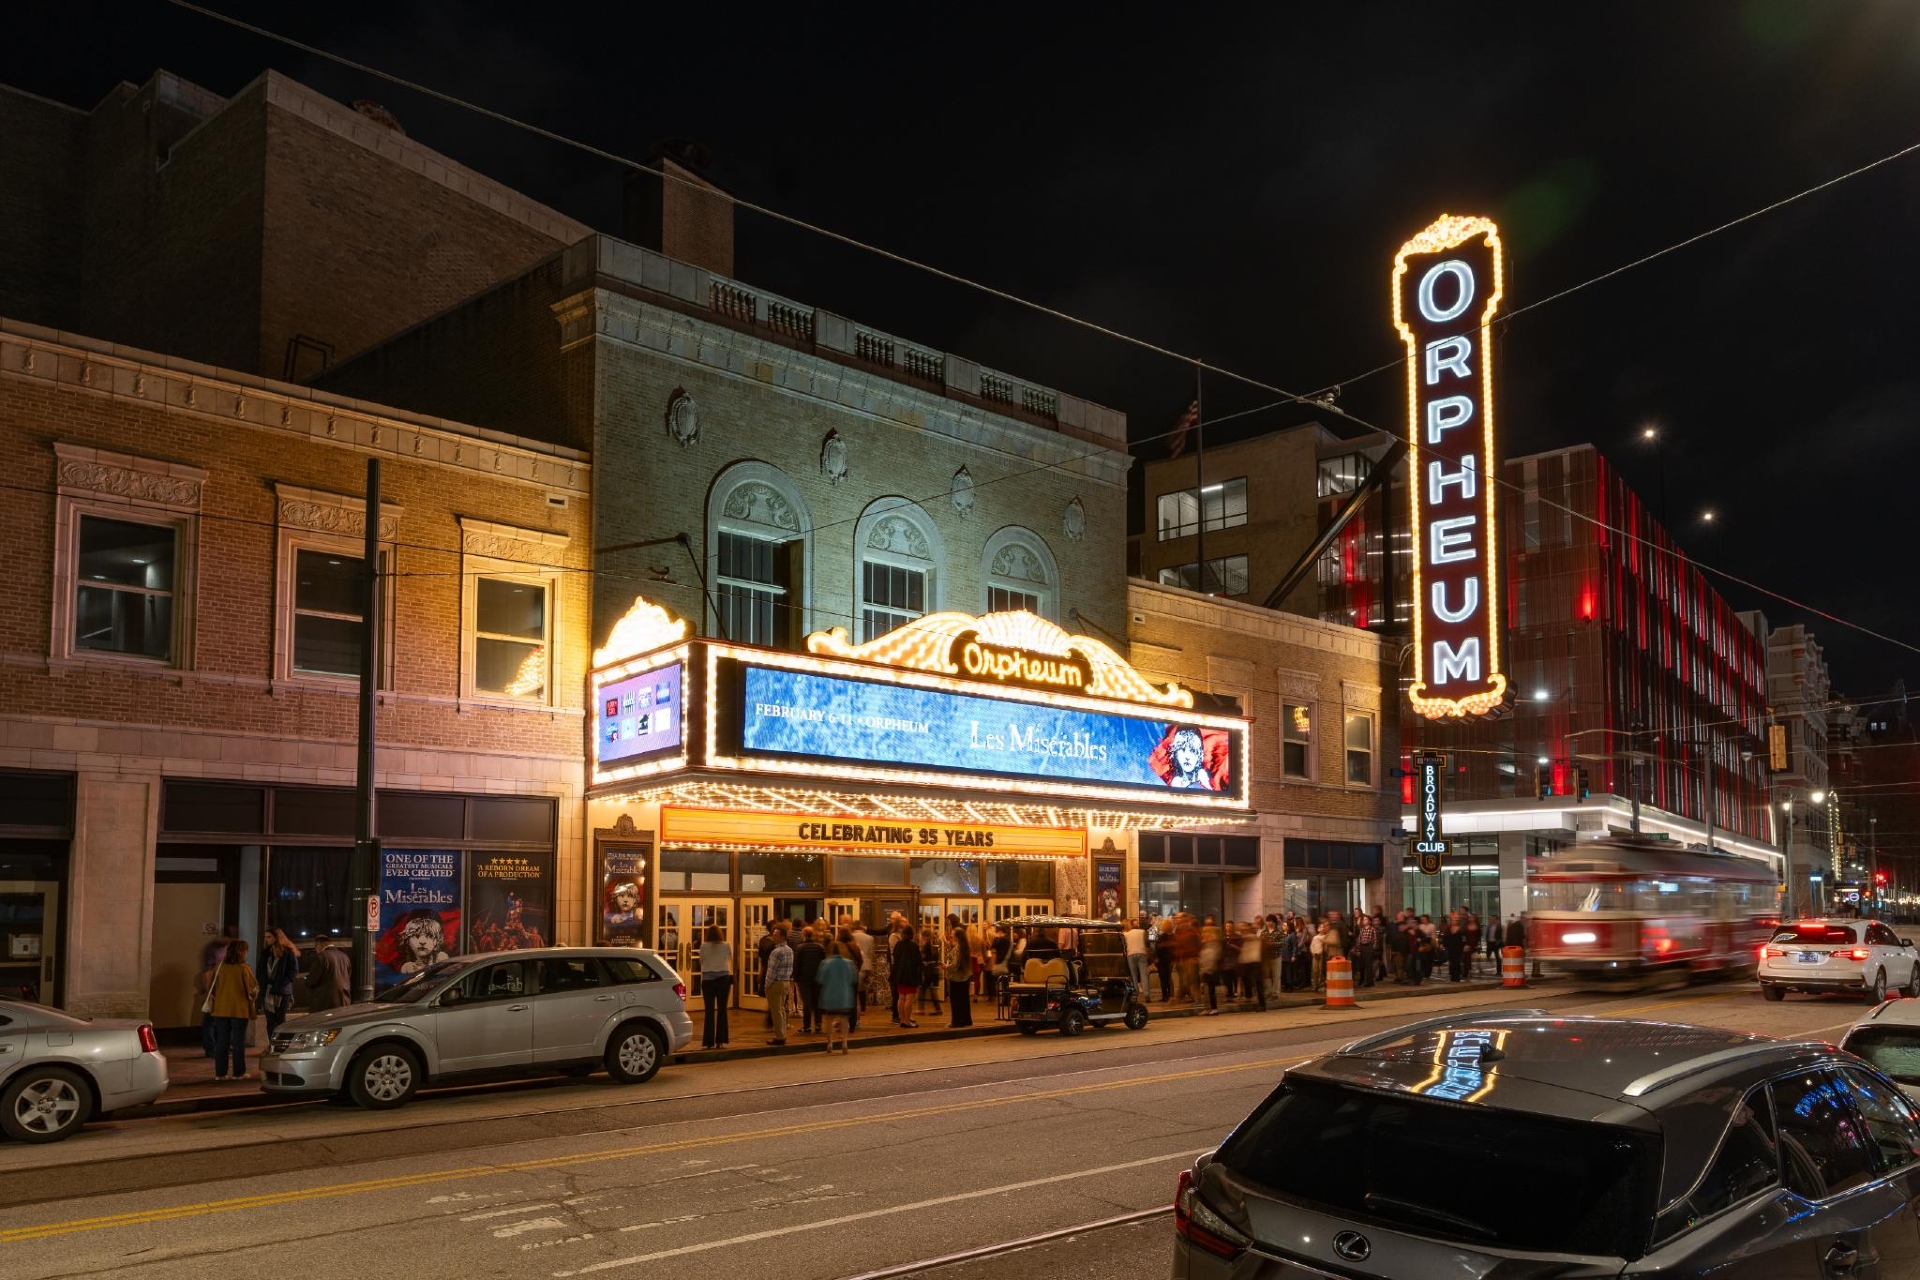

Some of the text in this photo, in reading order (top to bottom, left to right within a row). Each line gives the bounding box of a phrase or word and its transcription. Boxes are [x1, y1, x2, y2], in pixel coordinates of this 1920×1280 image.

[1418, 259, 1481, 686] ORPHEUM
[963, 642, 1083, 687] Orpheum
[755, 703, 826, 722] FEBRUARY
[866, 716, 930, 734] ORPHEUM
[969, 720, 1108, 761] Les Misérables
[1425, 765, 1436, 841] BROADWAY
[798, 823, 994, 847] CELEBRATING 95 YEARS
[1416, 842, 1445, 853] CLUB
[413, 854, 428, 863] OF
[429, 854, 454, 864] THE
[385, 868, 410, 877] EVER
[477, 870, 488, 878] OF
[384, 889, 454, 904] Misérables
[410, 882, 427, 894] Les
